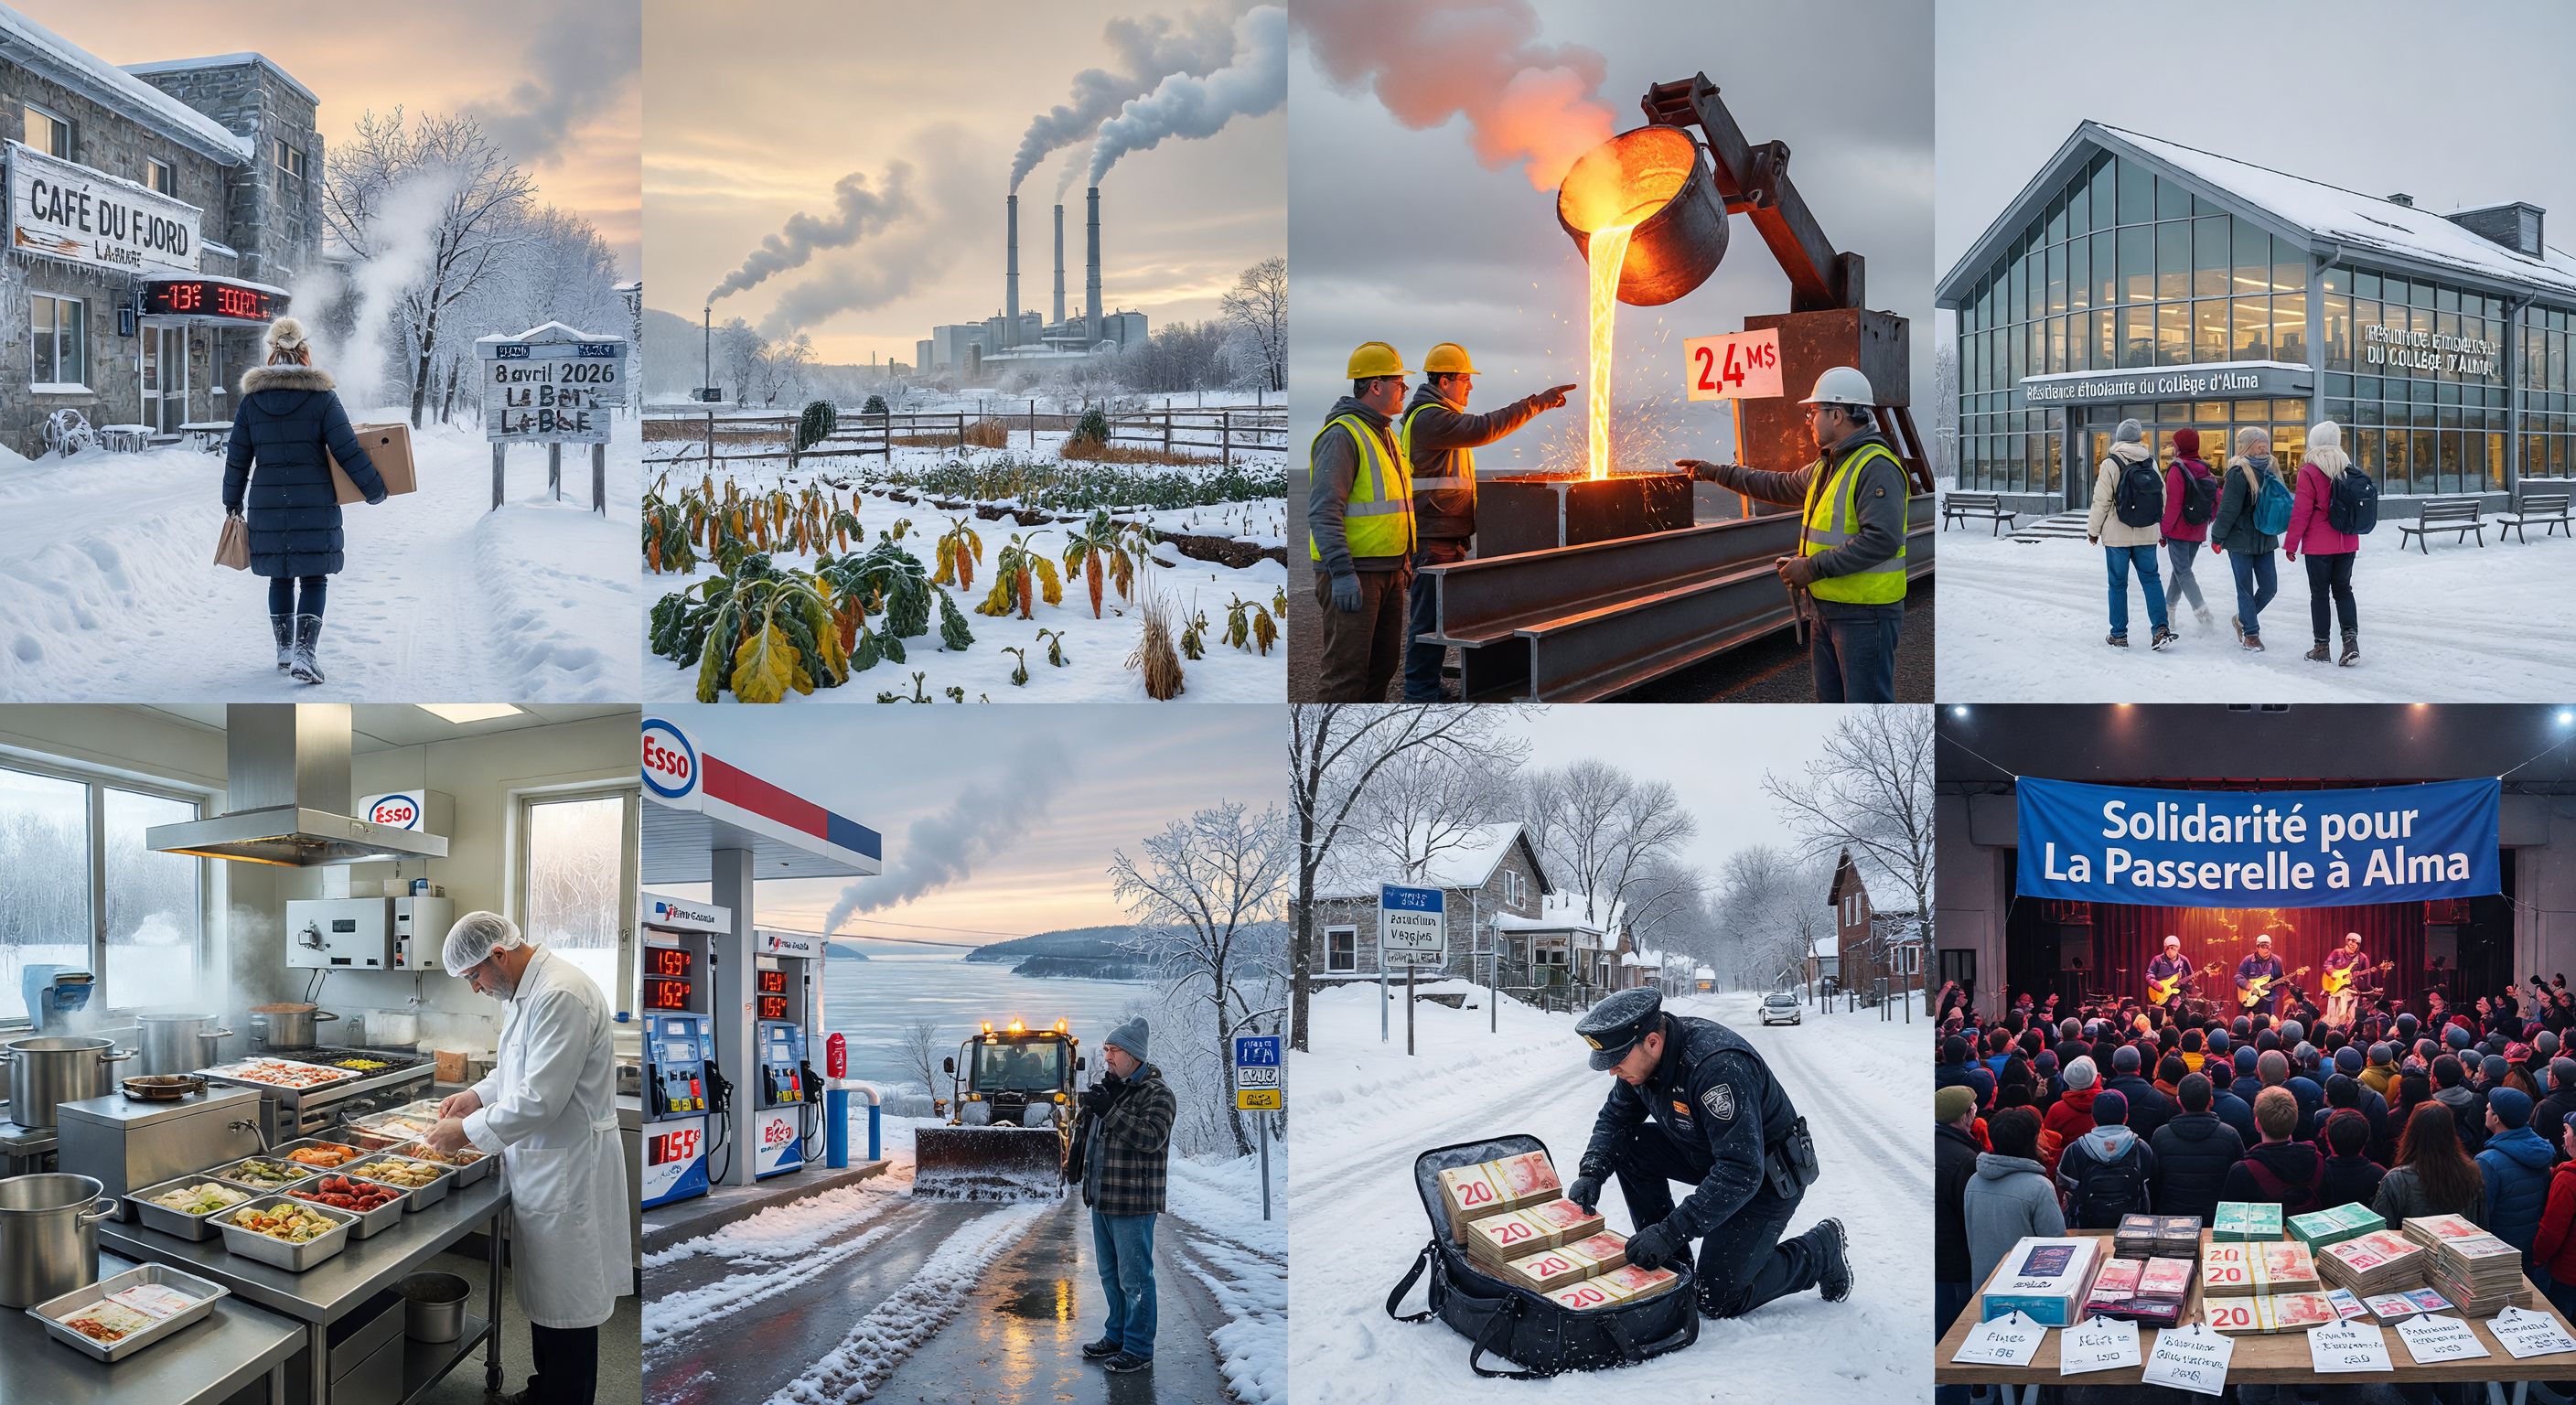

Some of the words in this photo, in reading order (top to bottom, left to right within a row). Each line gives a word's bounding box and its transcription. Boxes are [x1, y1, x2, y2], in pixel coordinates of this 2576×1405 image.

[31, 179, 91, 232] CAFÉ
[99, 199, 125, 241] DU
[133, 211, 188, 256] FJORD
[496, 365, 507, 382] 8
[512, 363, 552, 381] avril
[561, 363, 615, 382] 2026
[2141, 379, 2154, 393] du
[2159, 374, 2206, 395] Collège
[2102, 799, 2306, 843] Solidarité
[2320, 807, 2419, 853] pour
[2044, 842, 2091, 883] La
[2105, 848, 2314, 891] Passerelle
[2325, 850, 2350, 888] à
[2362, 846, 2470, 887] Alma
[1457, 1181, 1493, 1206] 20
[1489, 1222, 1532, 1244] 20
[2210, 1249, 2238, 1261] 20
[1527, 1257, 1571, 1277] 20
[2208, 1267, 2241, 1282] 20
[1560, 1287, 1605, 1308] 20
[2211, 1307, 2249, 1326] 20
